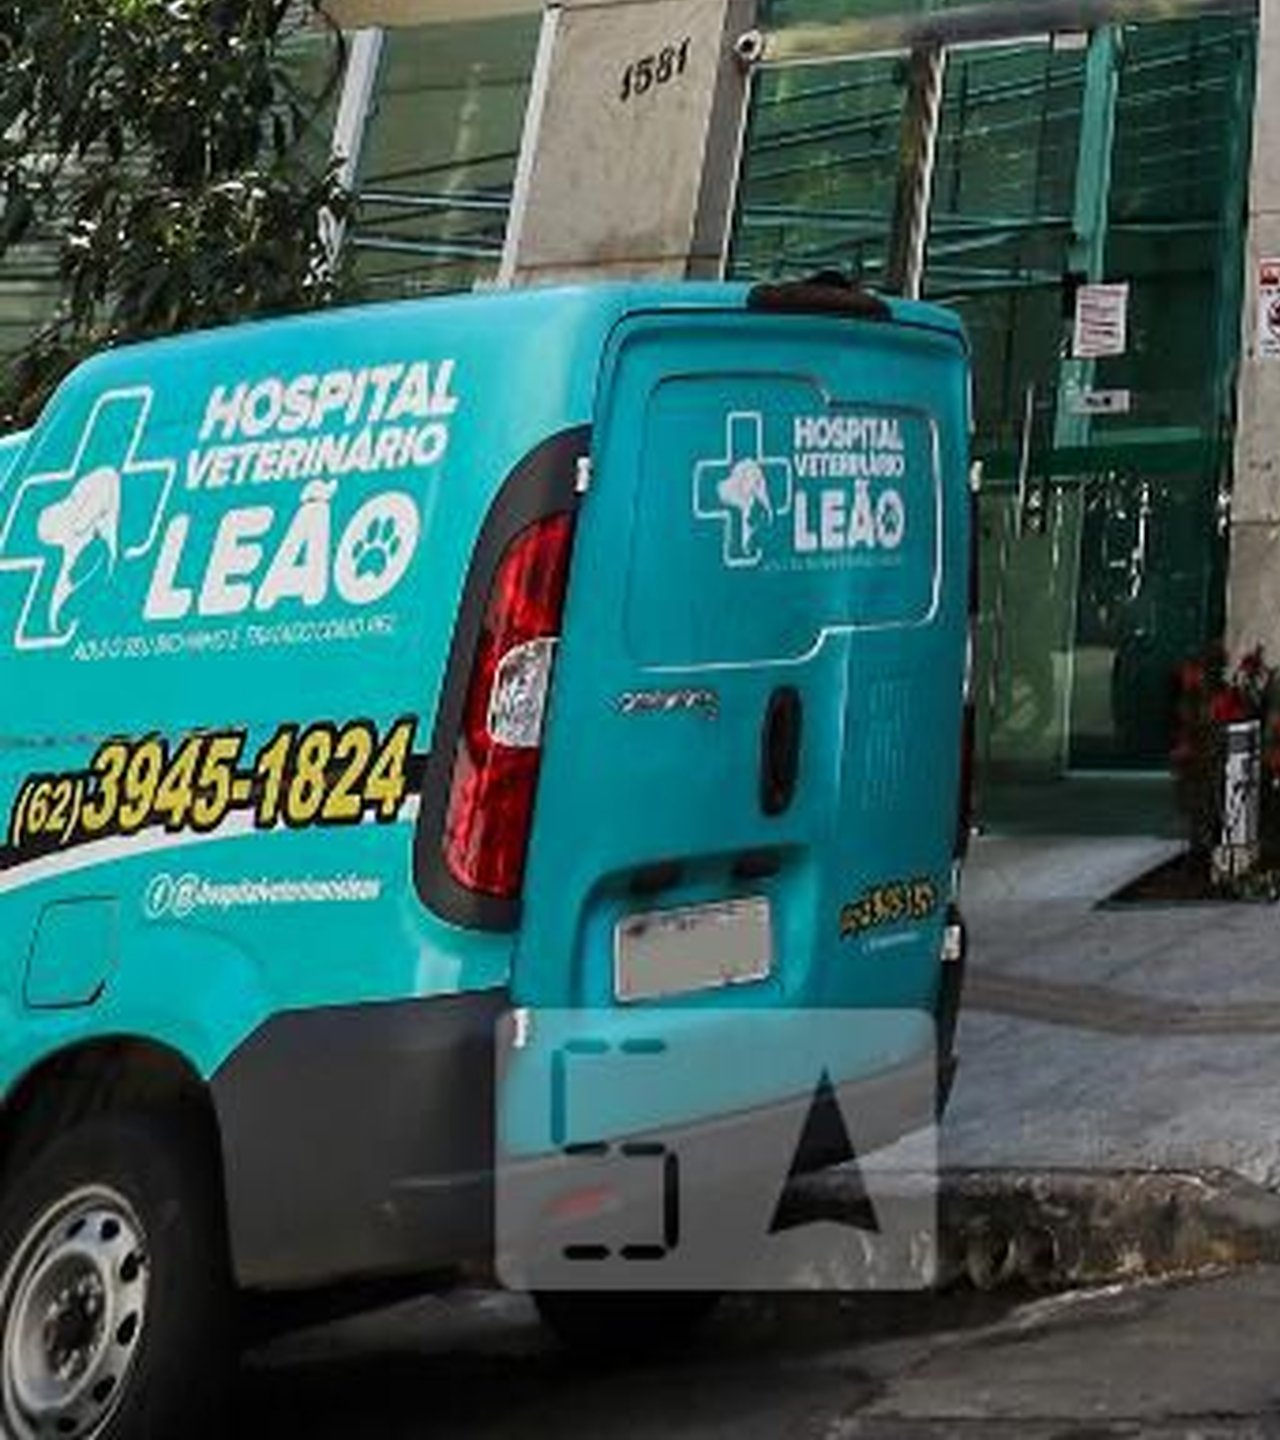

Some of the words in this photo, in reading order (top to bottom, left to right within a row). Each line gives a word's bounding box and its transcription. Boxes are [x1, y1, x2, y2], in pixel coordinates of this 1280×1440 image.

[620, 36, 691, 103] 1581
[200, 359, 459, 440] HOSPITAL
[794, 416, 904, 450] HOSPITAL
[143, 479, 420, 620] LEÃO
[794, 478, 905, 552] LEÃO
